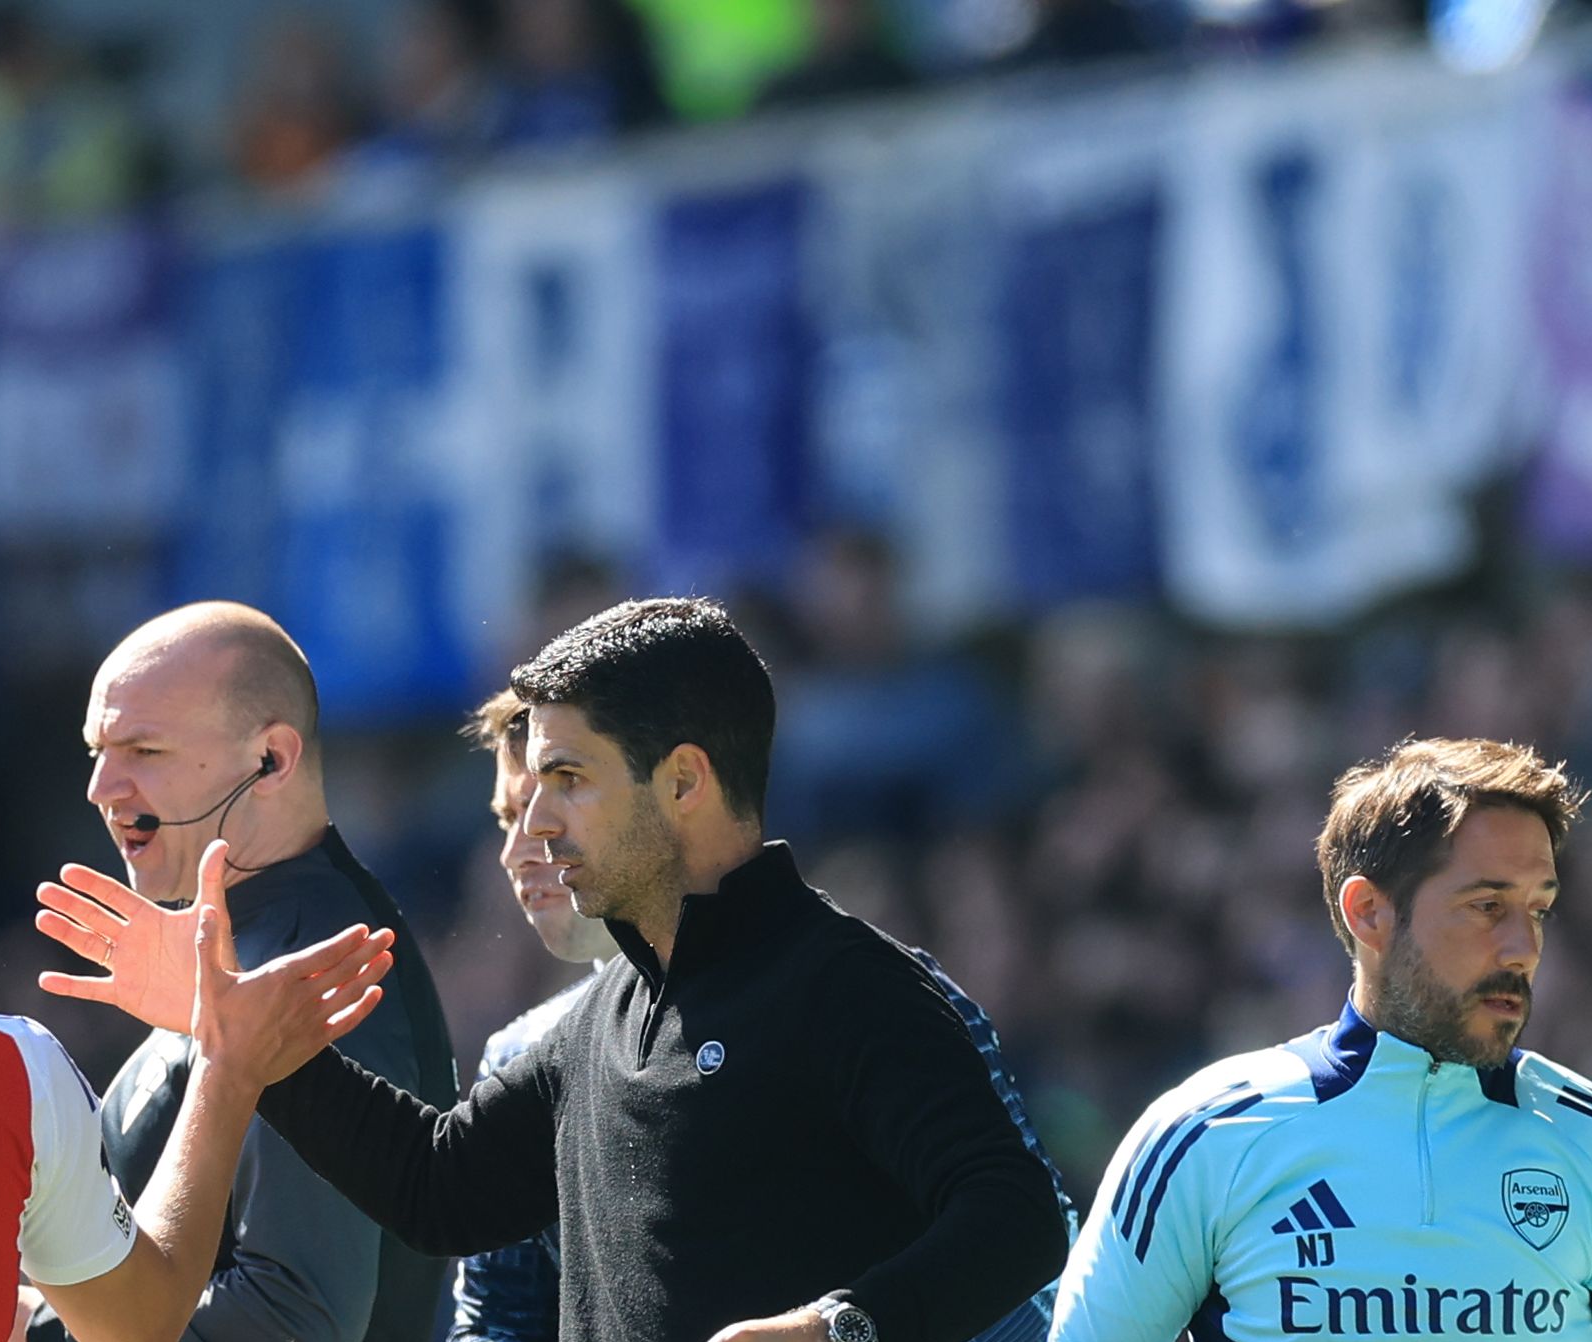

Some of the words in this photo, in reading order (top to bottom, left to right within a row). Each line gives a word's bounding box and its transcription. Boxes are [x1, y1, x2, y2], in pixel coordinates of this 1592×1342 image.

[1512, 1182, 1559, 1196] Arsenal
[1296, 1233, 1335, 1268] NJ
[1276, 1274, 1570, 1335] Emirates
